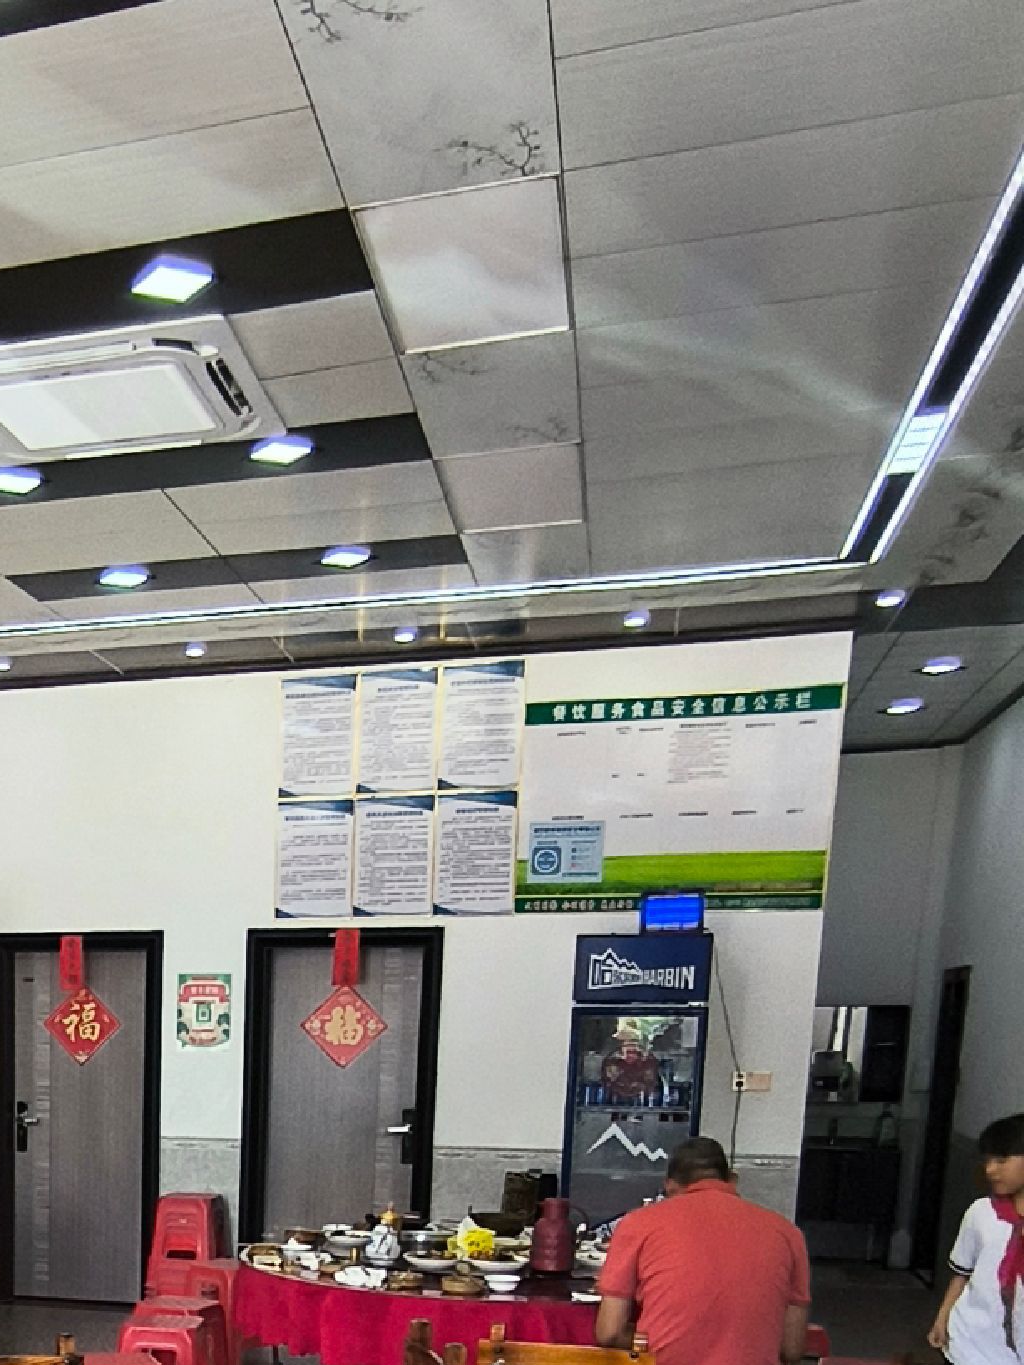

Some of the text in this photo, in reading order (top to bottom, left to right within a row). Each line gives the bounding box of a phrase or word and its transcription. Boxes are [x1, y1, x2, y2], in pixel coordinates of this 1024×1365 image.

[552, 690, 812, 722] 餐饮服务食品安全信息公示栏
[61, 1002, 101, 1042] 福
[324, 1004, 364, 1046] 福
